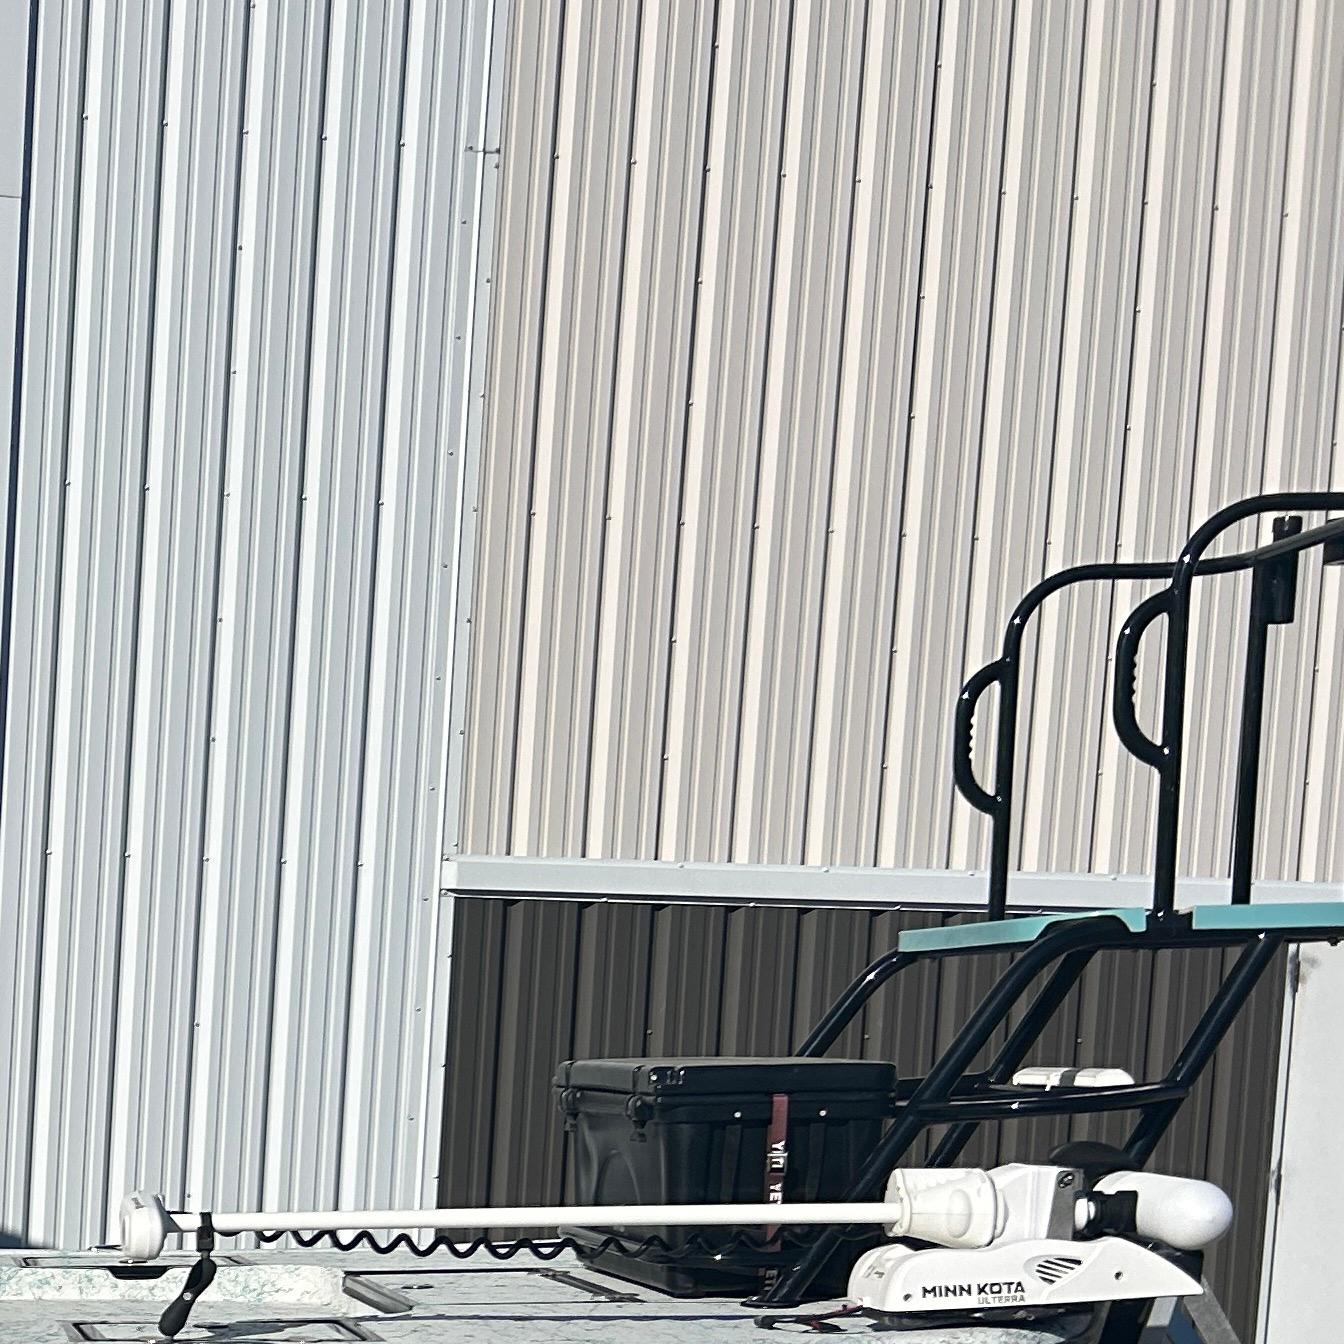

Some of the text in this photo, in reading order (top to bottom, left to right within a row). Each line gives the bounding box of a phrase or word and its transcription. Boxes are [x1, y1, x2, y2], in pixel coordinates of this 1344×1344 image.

[921, 1281, 1026, 1299] MINN KOTA
[977, 1295, 1026, 1305] ULTERRA
